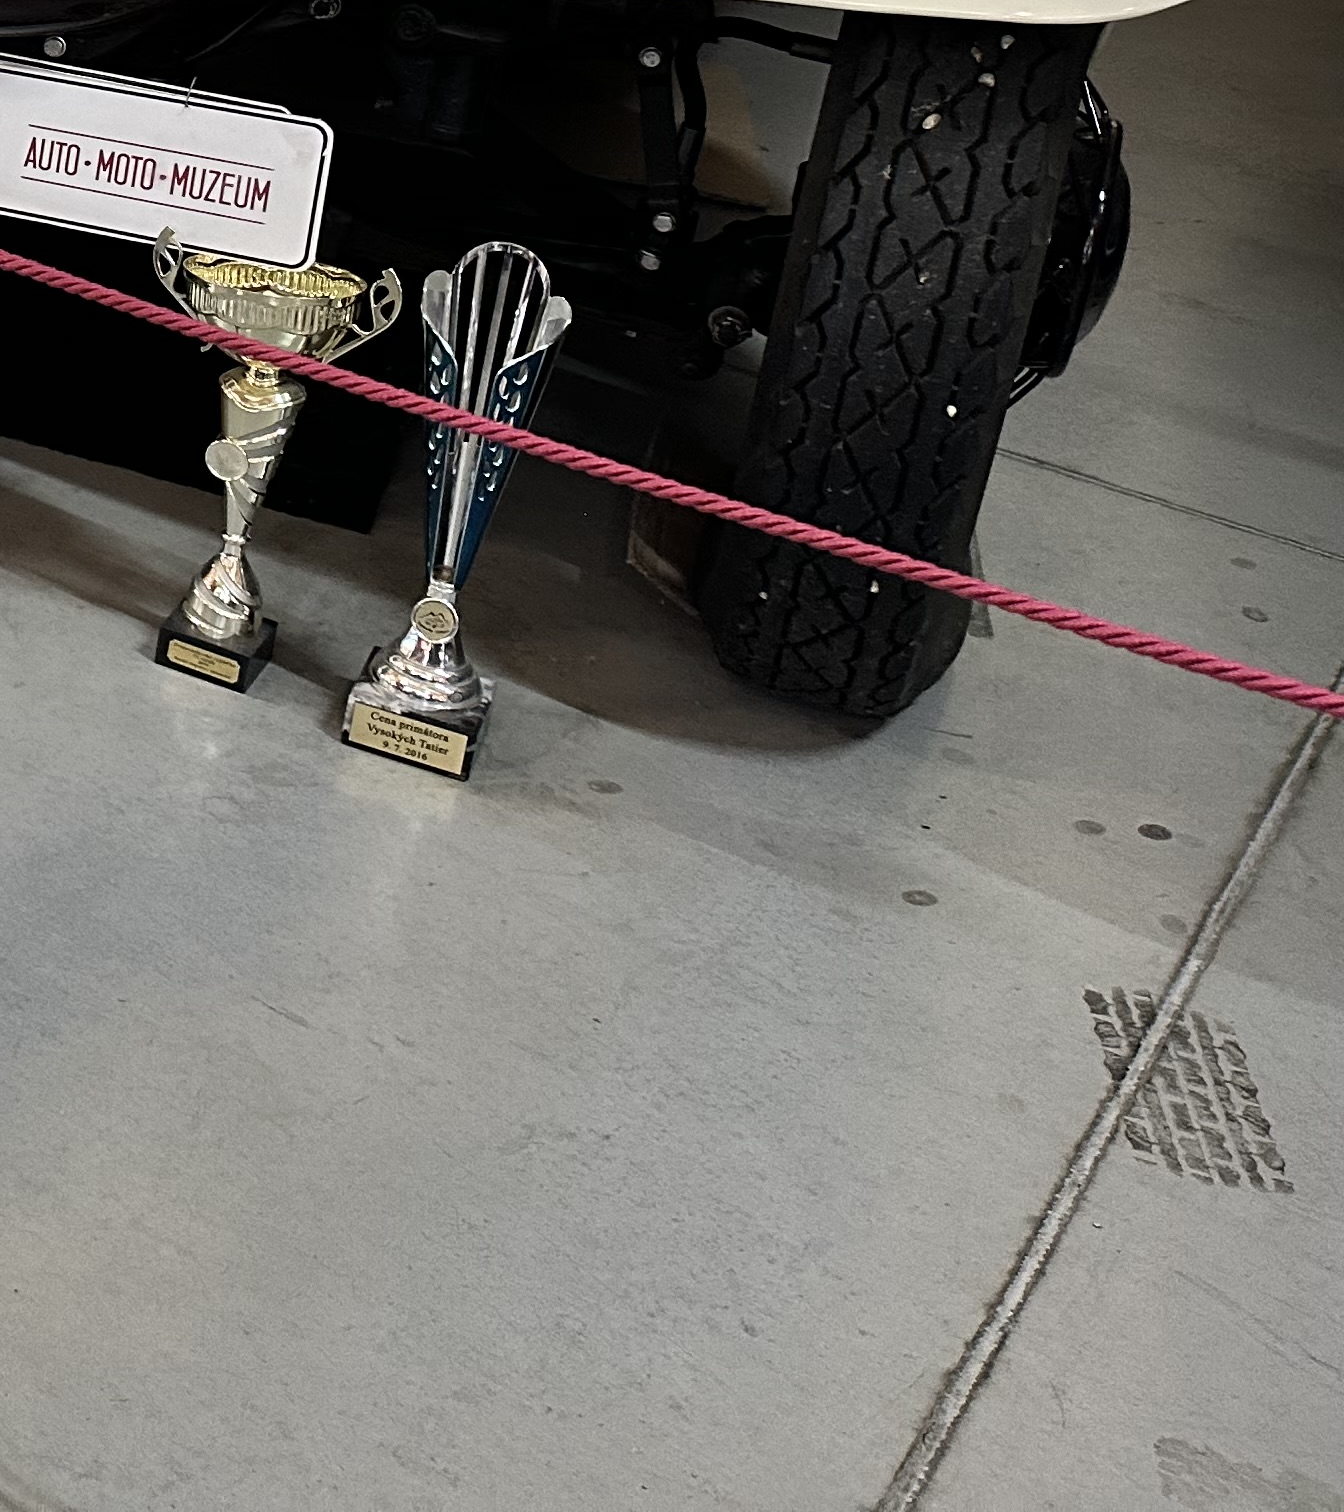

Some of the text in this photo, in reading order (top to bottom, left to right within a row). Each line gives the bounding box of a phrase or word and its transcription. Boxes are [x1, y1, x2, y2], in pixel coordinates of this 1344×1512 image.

[24, 137, 271, 213] AUTO MOTO MUZEUM
[370, 711, 449, 743] Cena primátora
[404, 746, 428, 761] 2016
